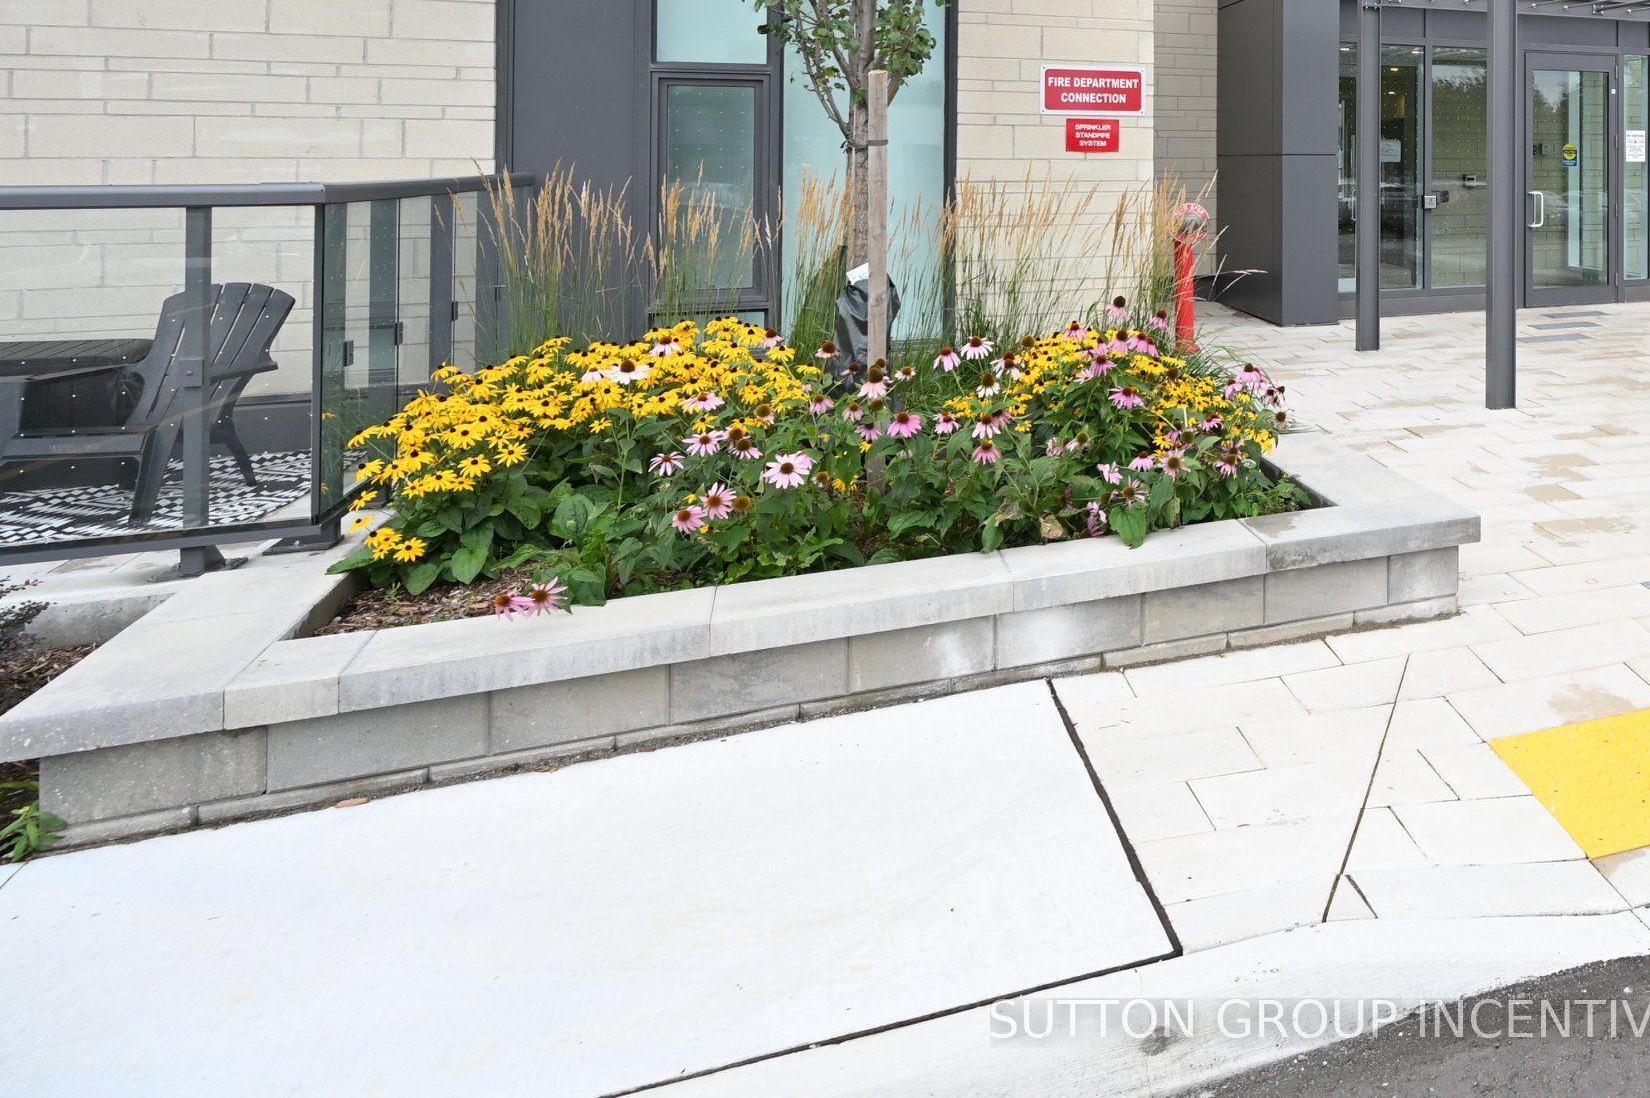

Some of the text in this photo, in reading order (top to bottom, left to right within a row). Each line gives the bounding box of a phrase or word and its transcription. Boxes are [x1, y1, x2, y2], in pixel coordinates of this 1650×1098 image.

[1047, 76, 1139, 89] FIRE DEPARTMENT
[1061, 92, 1127, 104] CONNECTION
[1075, 123, 1111, 131] SPRINKLER
